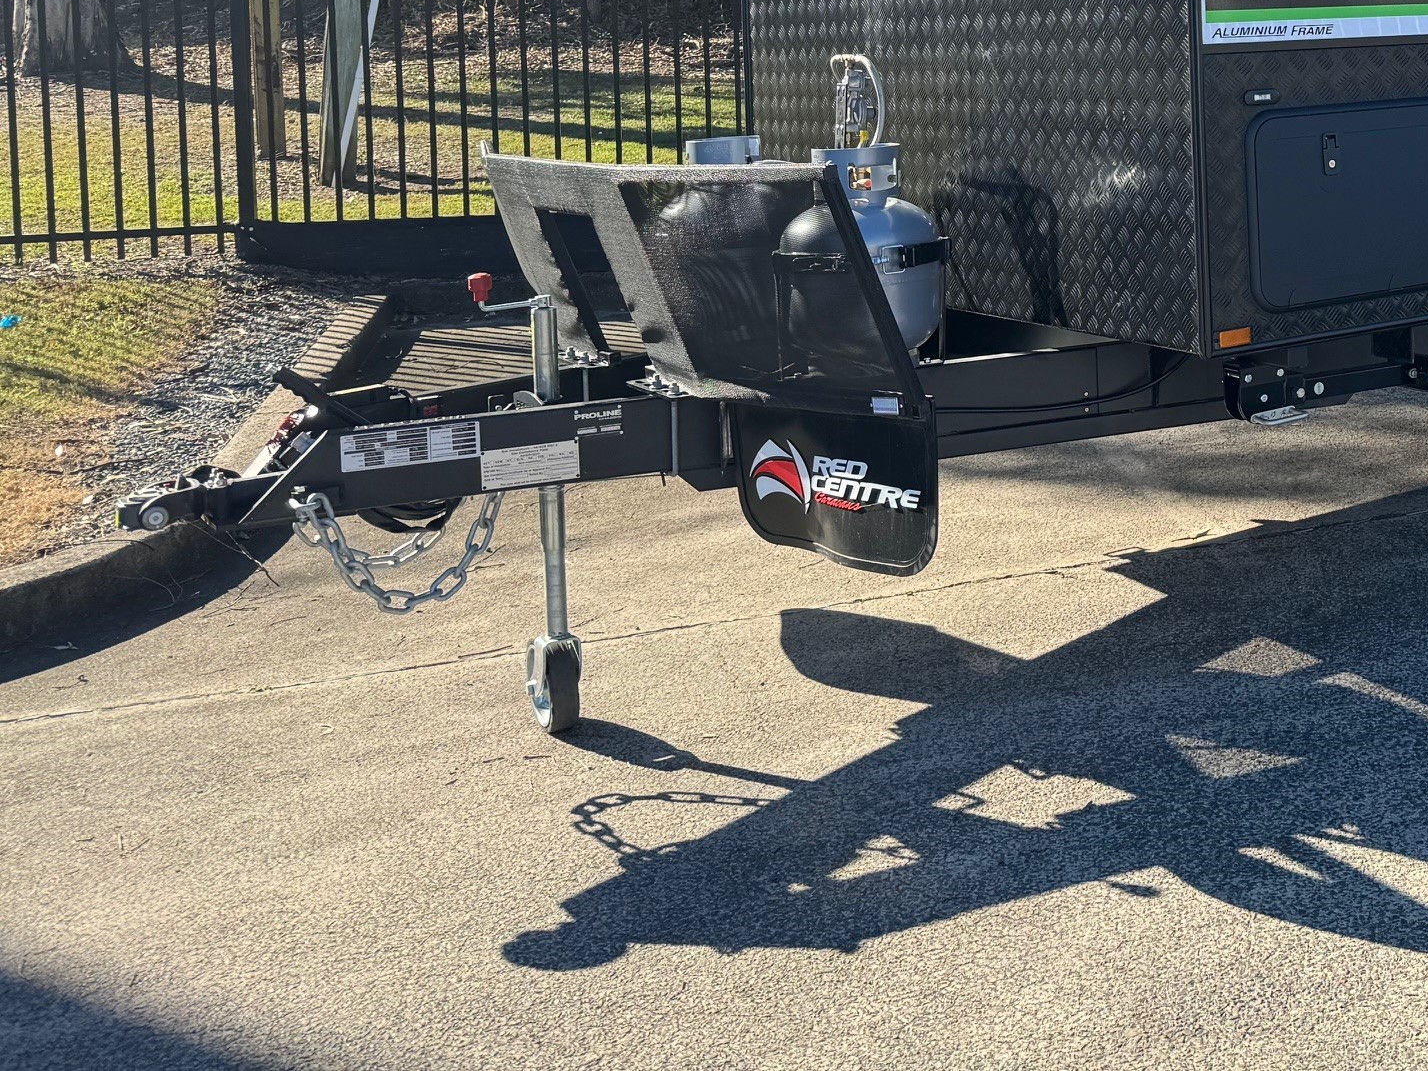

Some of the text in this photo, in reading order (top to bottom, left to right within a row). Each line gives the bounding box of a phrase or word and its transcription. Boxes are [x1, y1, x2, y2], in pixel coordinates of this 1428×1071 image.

[1212, 23, 1334, 39] ALUMINIUM FRAME
[574, 409, 622, 421] PROLINE
[812, 455, 869, 480] RED
[810, 475, 922, 509] CENTRE
